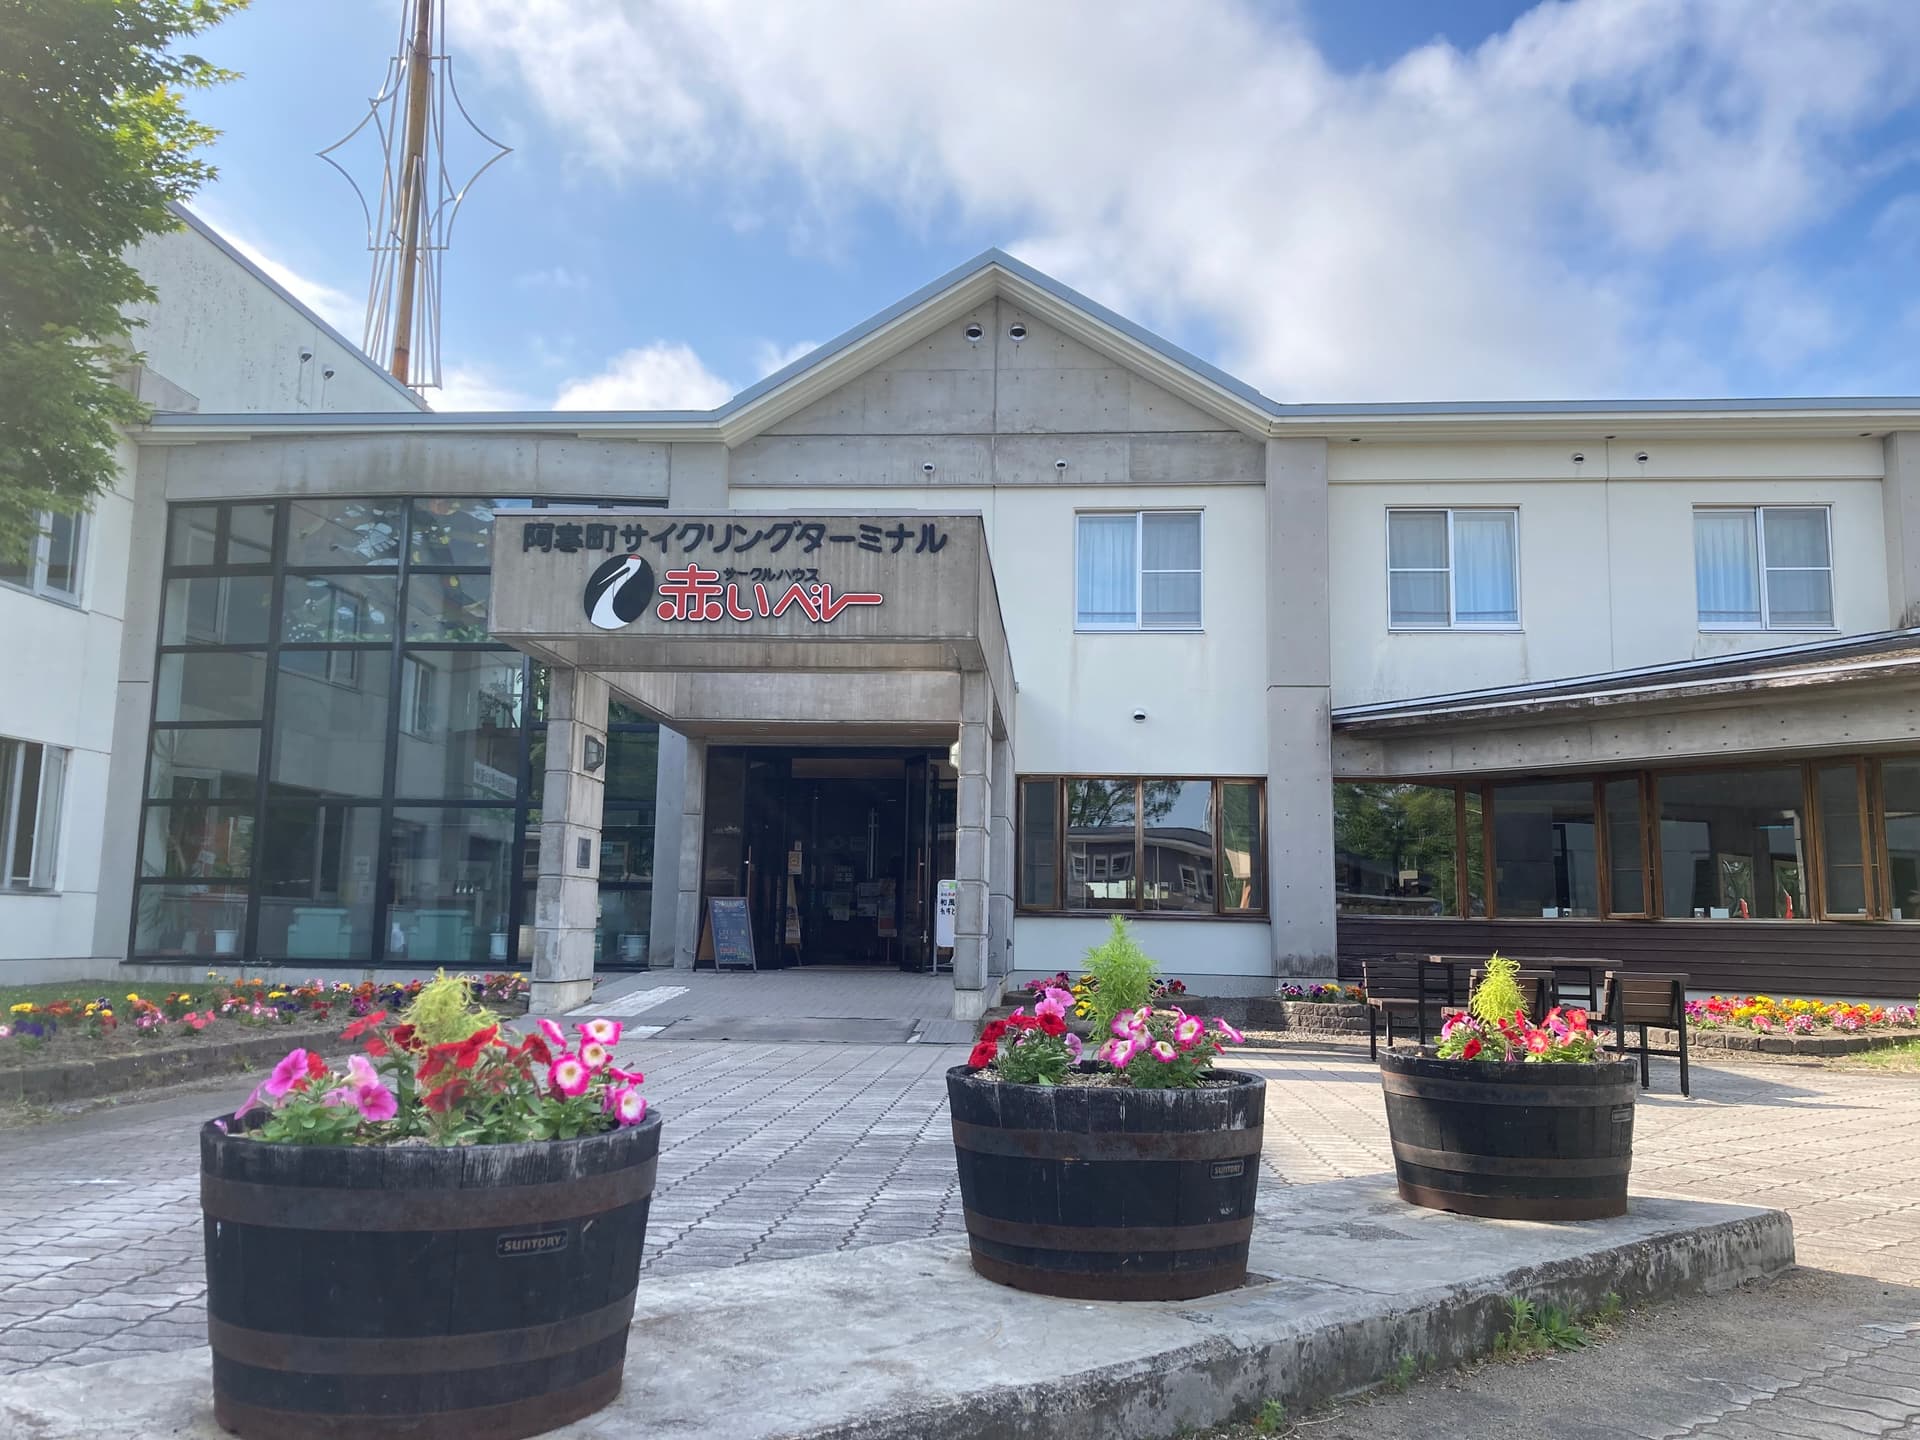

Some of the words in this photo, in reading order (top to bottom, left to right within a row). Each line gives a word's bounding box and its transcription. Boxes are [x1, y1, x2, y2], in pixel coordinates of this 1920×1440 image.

[523, 519, 948, 553] 阿寒町サイクリングターミナル
[723, 567, 820, 582] サークルハウス
[656, 563, 884, 622] 赤いベレー
[503, 1236, 561, 1251] SUNTORY
